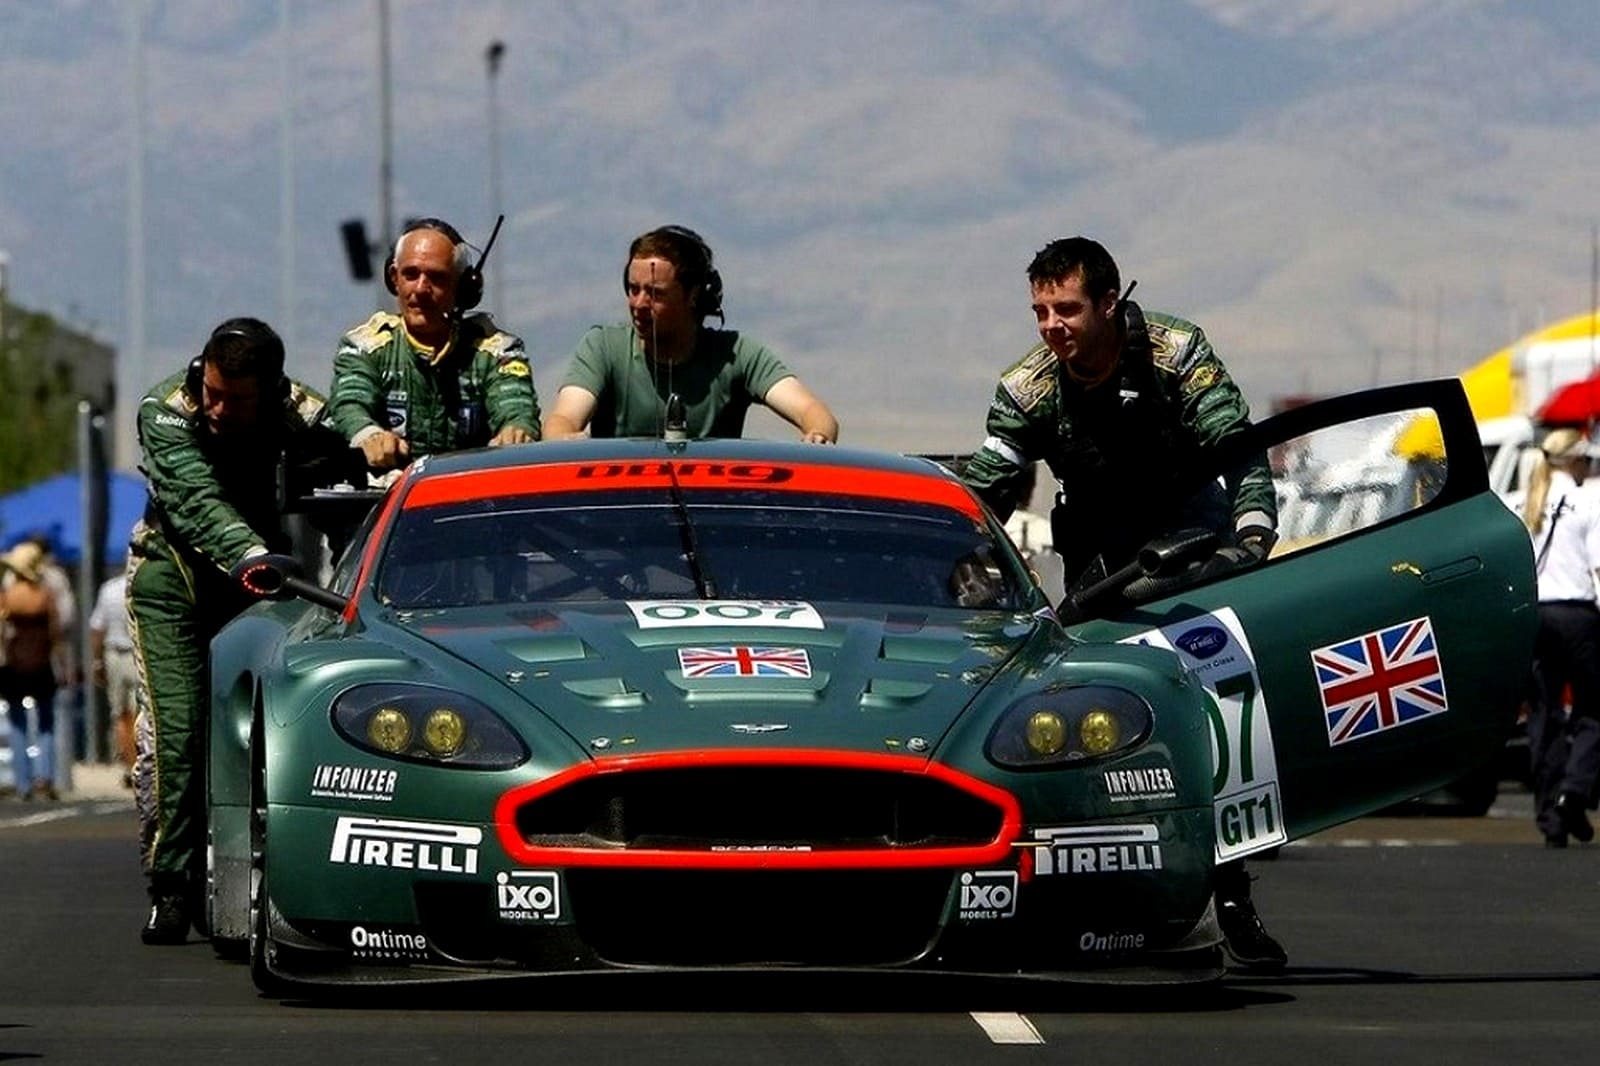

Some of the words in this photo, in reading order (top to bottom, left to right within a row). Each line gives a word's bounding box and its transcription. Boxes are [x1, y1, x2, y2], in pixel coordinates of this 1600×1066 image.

[642, 604, 807, 620] 007
[313, 765, 398, 793] INFONIZER
[1104, 767, 1175, 794] INFONIZER
[1220, 792, 1276, 847] GT1
[330, 816, 482, 874] PIRELLI
[1034, 823, 1163, 875] PIRELLI
[499, 910, 540, 920] MODELS
[960, 910, 998, 920] MODELS
[351, 925, 427, 950] Ontime
[1079, 931, 1145, 951] Ontime
